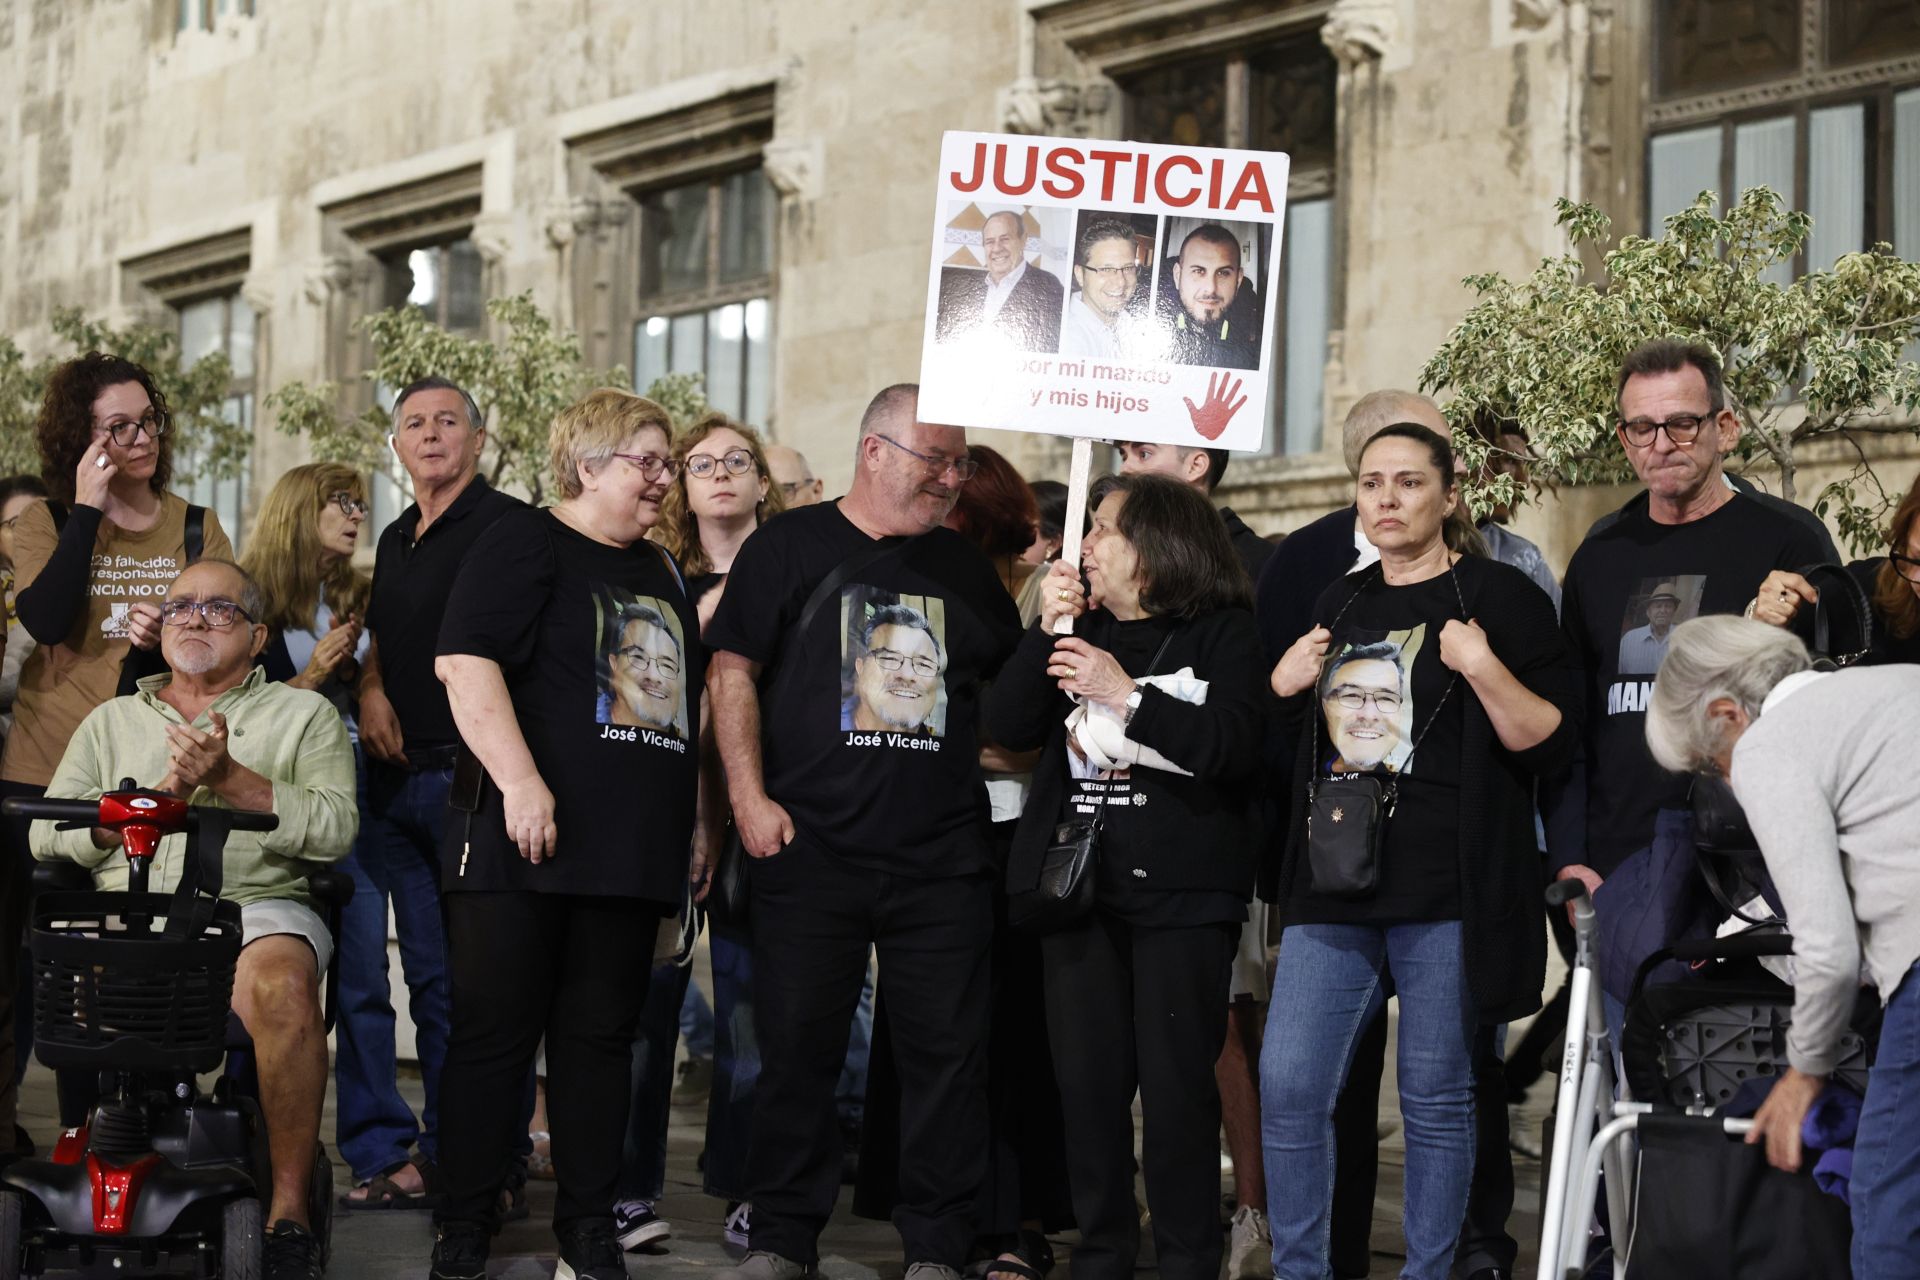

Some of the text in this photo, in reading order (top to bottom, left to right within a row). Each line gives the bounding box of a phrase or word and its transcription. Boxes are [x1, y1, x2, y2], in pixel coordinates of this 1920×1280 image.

[950, 142, 1275, 213] JUSTICIA
[1058, 359, 1085, 378] mi
[1030, 388, 1150, 414] y mis hijos
[115, 555, 176, 569] fallecidos
[86, 584, 126, 597] NCIA
[128, 584, 152, 597] NO
[600, 725, 686, 754] José Vicente
[845, 731, 941, 752] José Vicente
